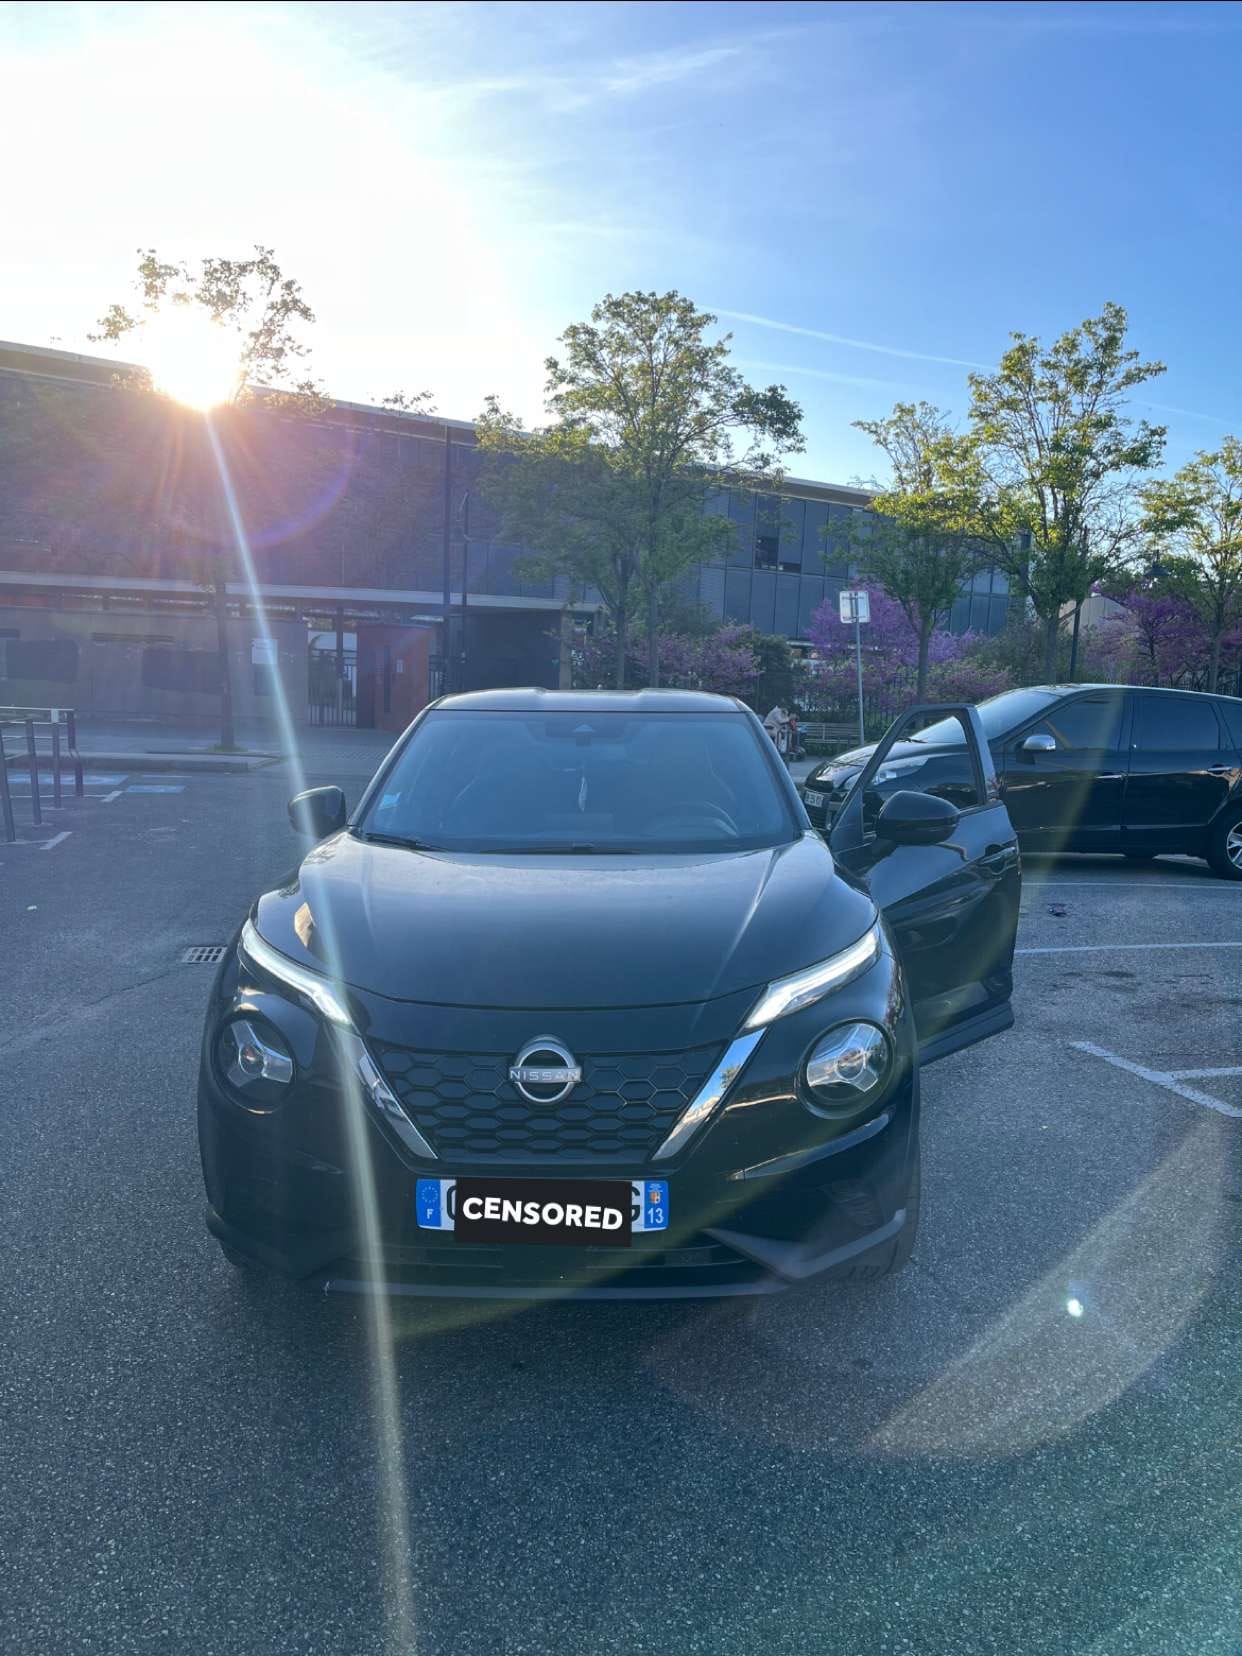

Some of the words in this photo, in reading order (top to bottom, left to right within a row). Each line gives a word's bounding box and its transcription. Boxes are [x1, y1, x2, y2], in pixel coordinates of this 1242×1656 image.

[510, 1070, 580, 1081] NISSAN
[427, 1208, 434, 1220] F
[648, 1207, 665, 1224] 13
